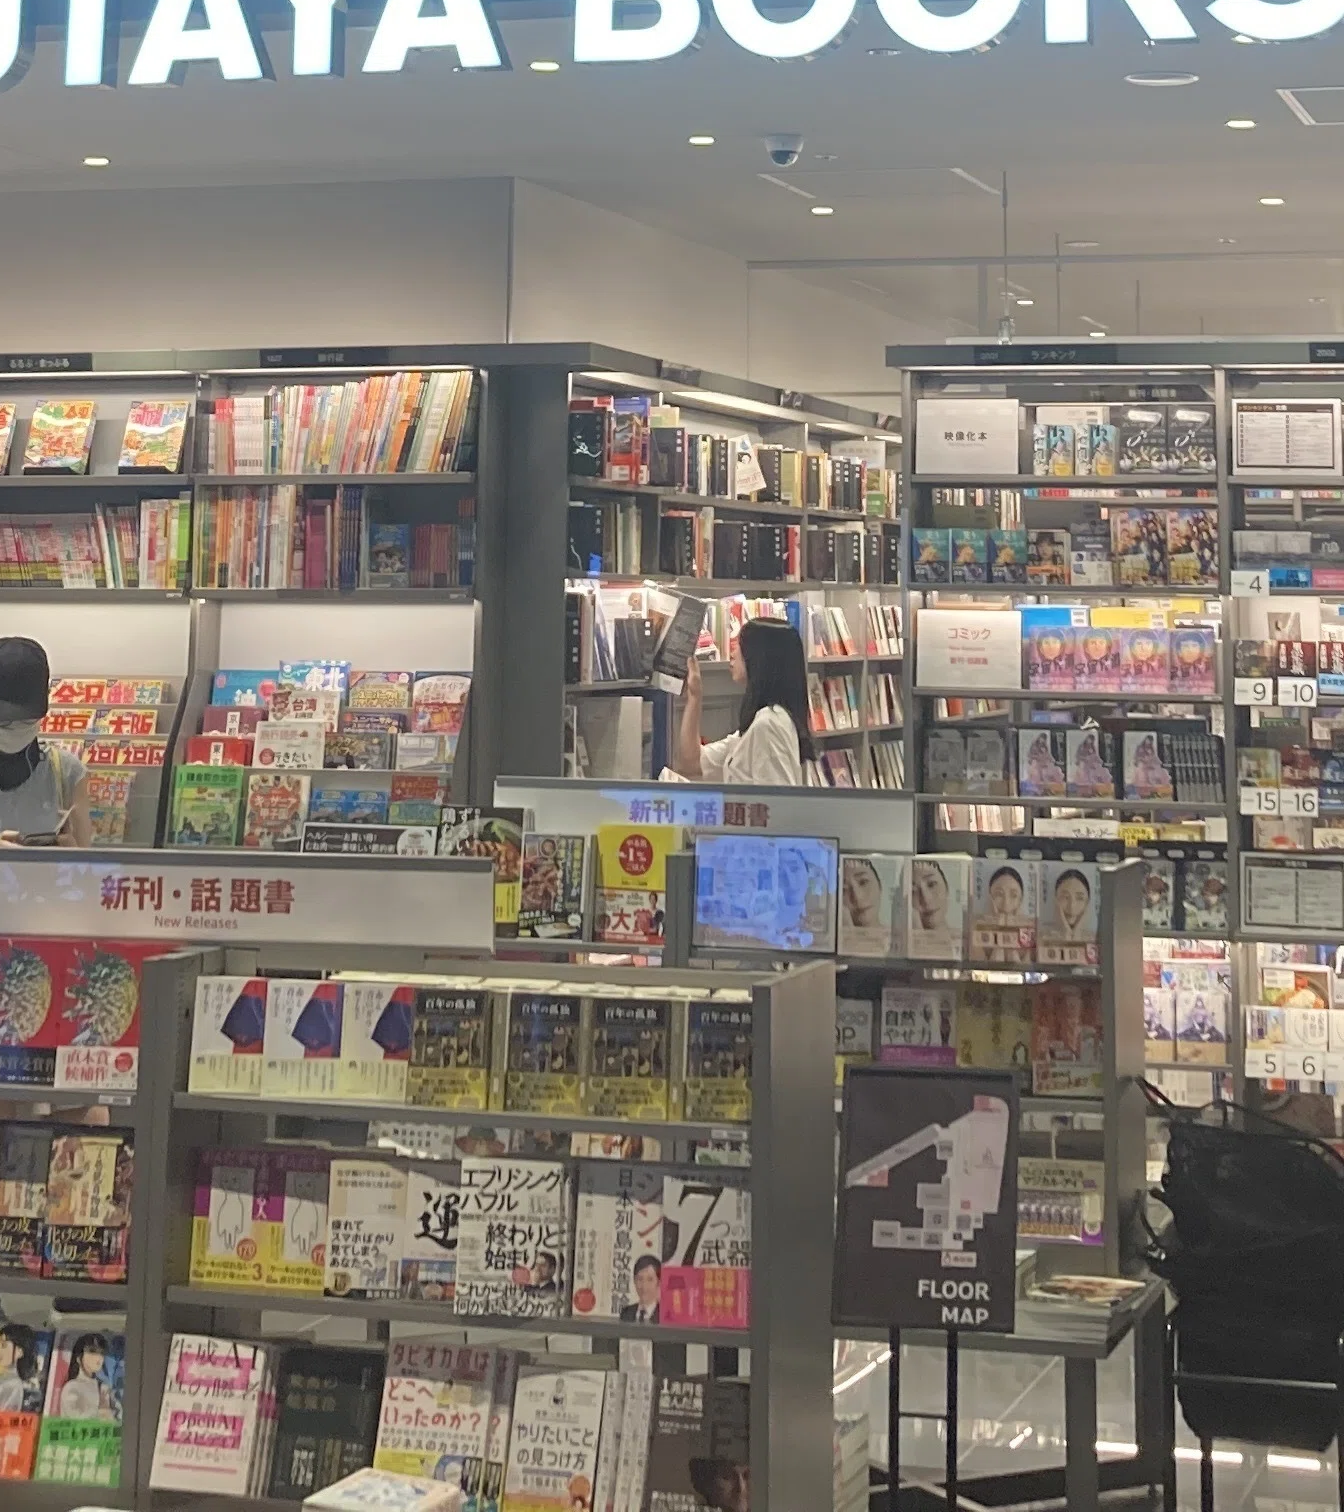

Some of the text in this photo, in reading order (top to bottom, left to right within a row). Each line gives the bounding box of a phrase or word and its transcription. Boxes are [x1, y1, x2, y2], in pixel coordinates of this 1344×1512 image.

[1030, 350, 1077, 361] ランキング
[943, 430, 989, 442] 映像化本
[1249, 577, 1263, 594] 4
[947, 627, 992, 641] コミック
[306, 666, 345, 692] 東北
[1253, 683, 1266, 701] 9
[1294, 684, 1313, 703] 10
[292, 697, 318, 713] 台湾
[1257, 791, 1276, 810] 15
[1295, 792, 1314, 812] 16
[628, 798, 770, 828] 新刊・話題書
[99, 874, 297, 916] 新刊・話題書
[154, 914, 239, 931] New Releases
[424, 996, 476, 1013] 百年の孤独
[520, 1001, 571, 1017] 百年の孤独
[603, 1006, 658, 1021] 百年の孤独
[884, 1008, 918, 1026] 自然
[62, 1050, 112, 1066] 直木賞
[1264, 1055, 1276, 1073] 5
[1302, 1056, 1315, 1075] 6
[462, 1166, 561, 1193] エブリシング
[678, 1183, 724, 1267] 7
[331, 1232, 395, 1246] スマホばかり
[484, 1223, 560, 1249] 終わりと
[330, 1244, 380, 1257] 見てしまう
[700, 1238, 751, 1267] 武器
[252, 1263, 263, 1280] 3
[329, 1257, 375, 1269] あなたへ
[917, 1279, 991, 1301] FLOOR
[941, 1306, 990, 1325] MAP
[172, 1336, 259, 1370] 生成AI
[392, 1342, 488, 1368] タピオカ屋は
[386, 1378, 435, 1402] どこへ
[172, 1412, 237, 1432] OpenAI
[382, 1406, 481, 1431] いったのか?
[515, 1422, 597, 1450] やりたいこと
[378, 1436, 480, 1458] ビジネスのカラクリ
[515, 1448, 587, 1470] の見つけ方
